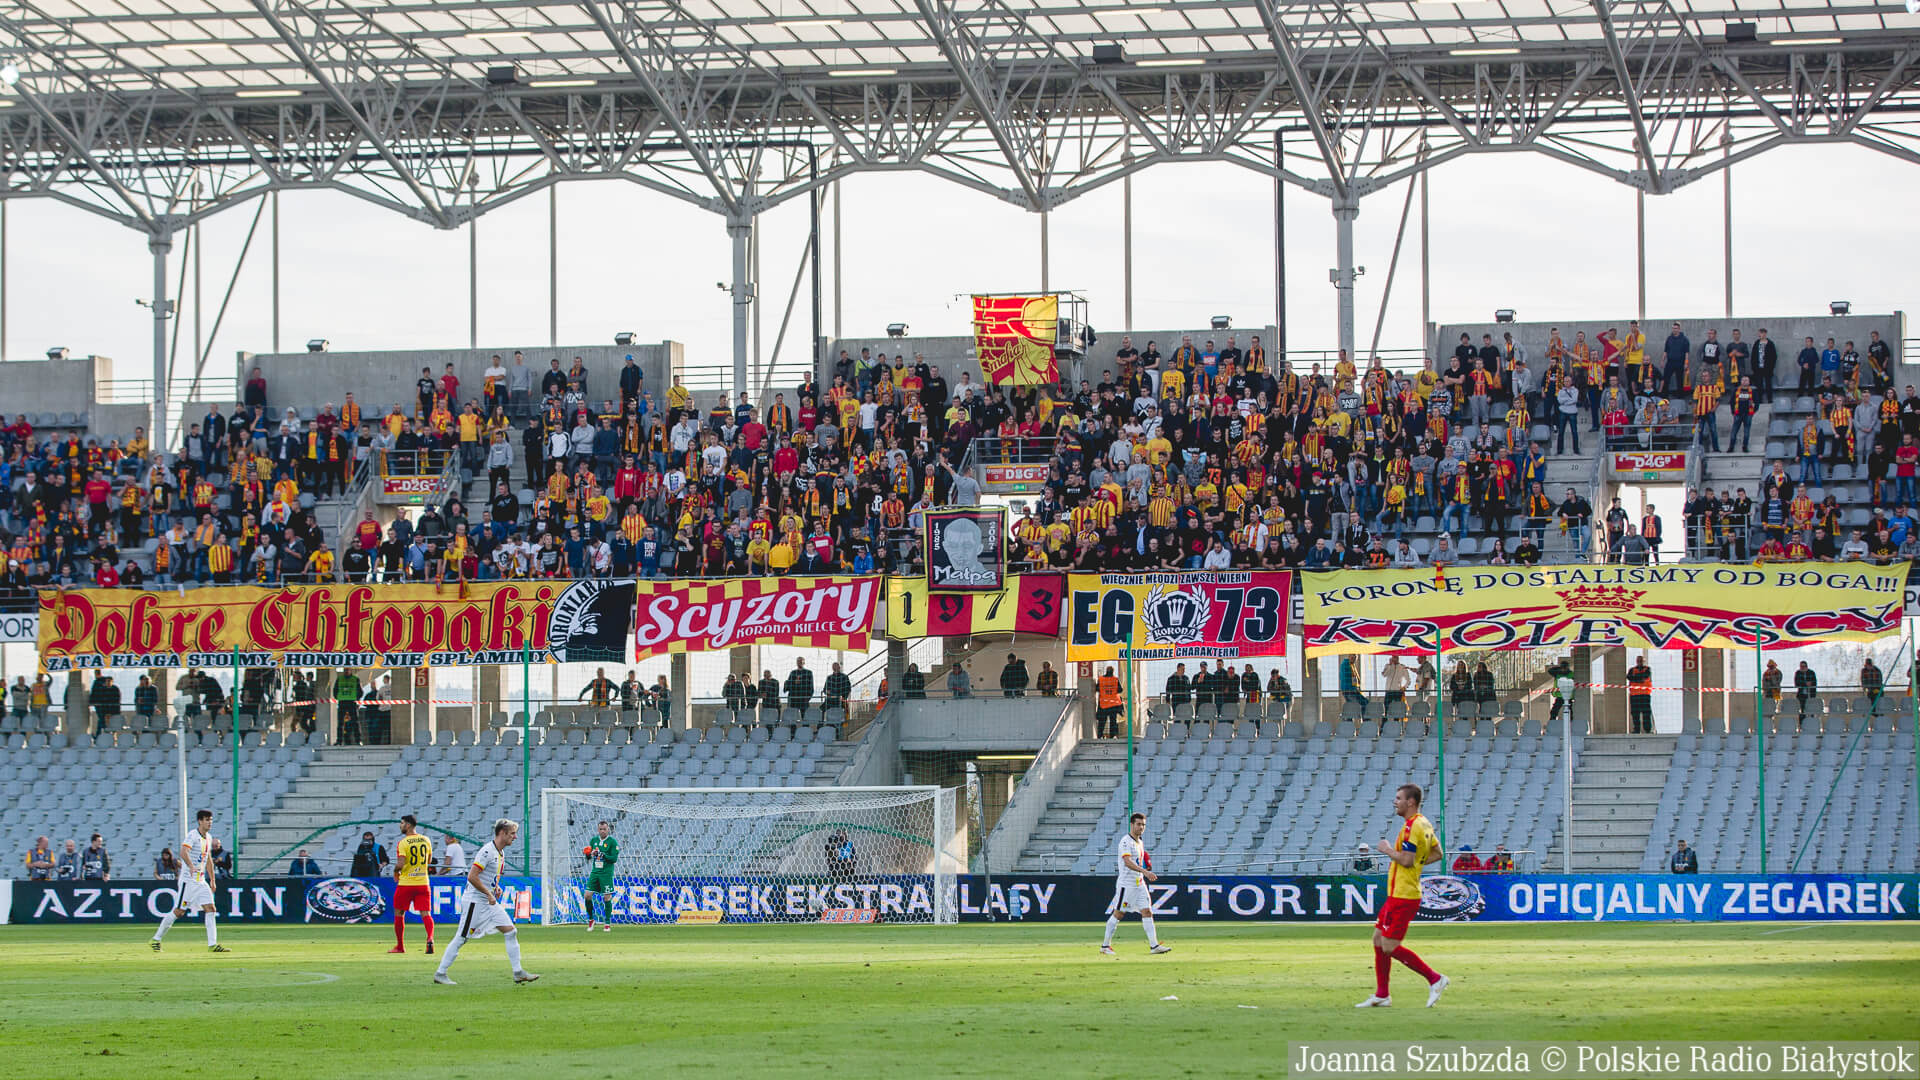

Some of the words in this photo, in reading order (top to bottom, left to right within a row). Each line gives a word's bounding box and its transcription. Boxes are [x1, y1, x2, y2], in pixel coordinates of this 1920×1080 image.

[402, 480, 430, 491] D2G
[1101, 574, 1144, 585] WIECZNIE
[1179, 572, 1216, 583] ZAWSZE
[1217, 571, 1251, 582] WIERNI
[1473, 566, 1704, 589] DOSTALIŚMY
[1713, 568, 1766, 586] OD
[1775, 570, 1898, 593] BOGA!!!
[38, 592, 227, 655] Dobre
[637, 581, 873, 648] Scyzory
[1072, 589, 1135, 645] EG
[1215, 587, 1281, 643] 73
[1306, 600, 1898, 651] KRÓLEWSCY
[736, 623, 791, 638] KORONA
[795, 621, 837, 633] KIELCE
[48, 658, 72, 670] ZA
[77, 655, 104, 667] TA
[111, 653, 180, 667] FLAGA
[285, 652, 375, 667] HONORU
[384, 651, 423, 666] NIE
[1176, 646, 1239, 658] CHARAKTERNI
[410, 843, 427, 866] 89
[33, 886, 287, 918] AZTOIN
[1508, 882, 1711, 921] OFICJALNY
[1722, 882, 1906, 914] ZEGAREK
